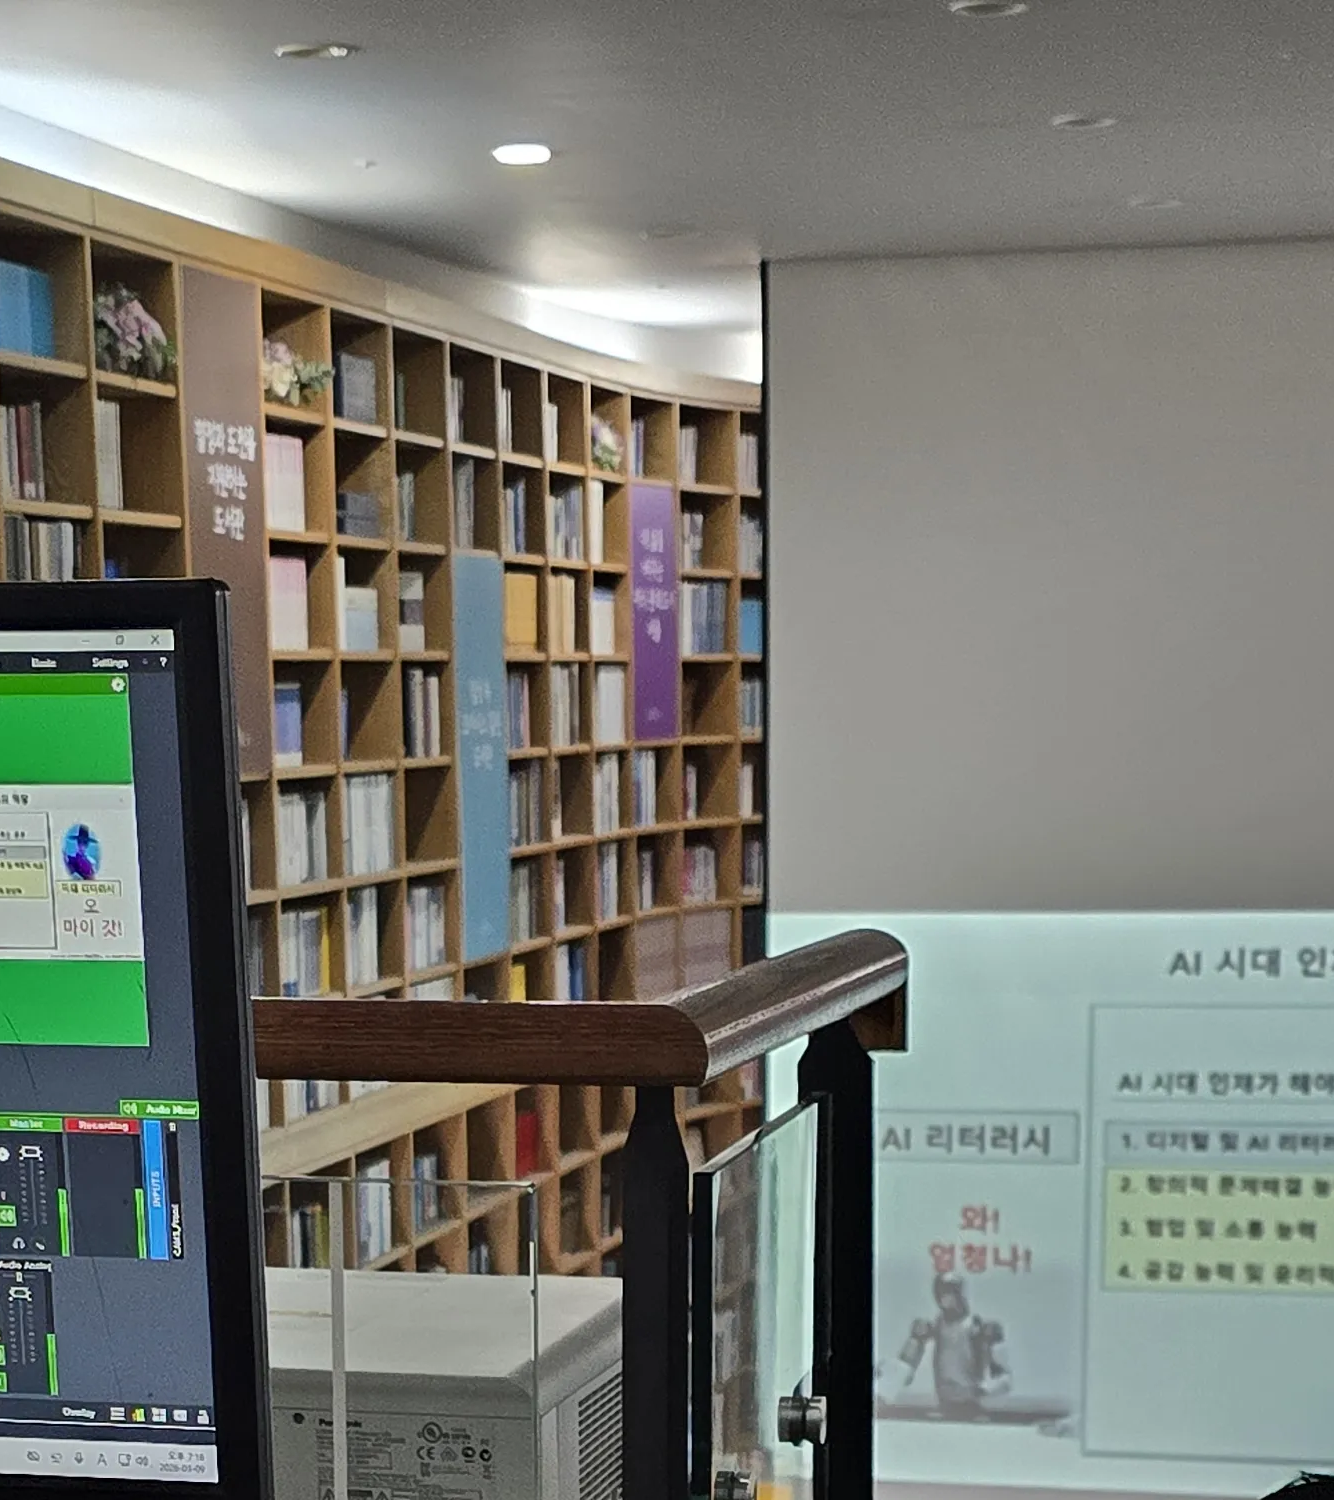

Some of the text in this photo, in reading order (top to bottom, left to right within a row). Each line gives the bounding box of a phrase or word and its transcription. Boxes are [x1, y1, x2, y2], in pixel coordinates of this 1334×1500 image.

[91, 656, 129, 669] Settings
[83, 899, 100, 914] 오
[63, 919, 123, 938] 마이 갓!
[1169, 950, 1202, 977] AI
[1216, 946, 1282, 979] 시대
[1117, 1073, 1143, 1093] AI
[1151, 1071, 1199, 1096] 시대
[1209, 1072, 1279, 1096] 인재가
[145, 1103, 170, 1115] Audio
[78, 1119, 128, 1133] Recording
[881, 1123, 1052, 1156] AI 리터러시
[1122, 1132, 1139, 1151] 1.
[1146, 1131, 1209, 1152] 디지털
[1246, 1134, 1269, 1151] AI
[1120, 1174, 1137, 1194] 2.
[959, 1203, 1000, 1235] 와!
[929, 1241, 1033, 1275] 엄청나!
[61, 1406, 97, 1420] Overlay
